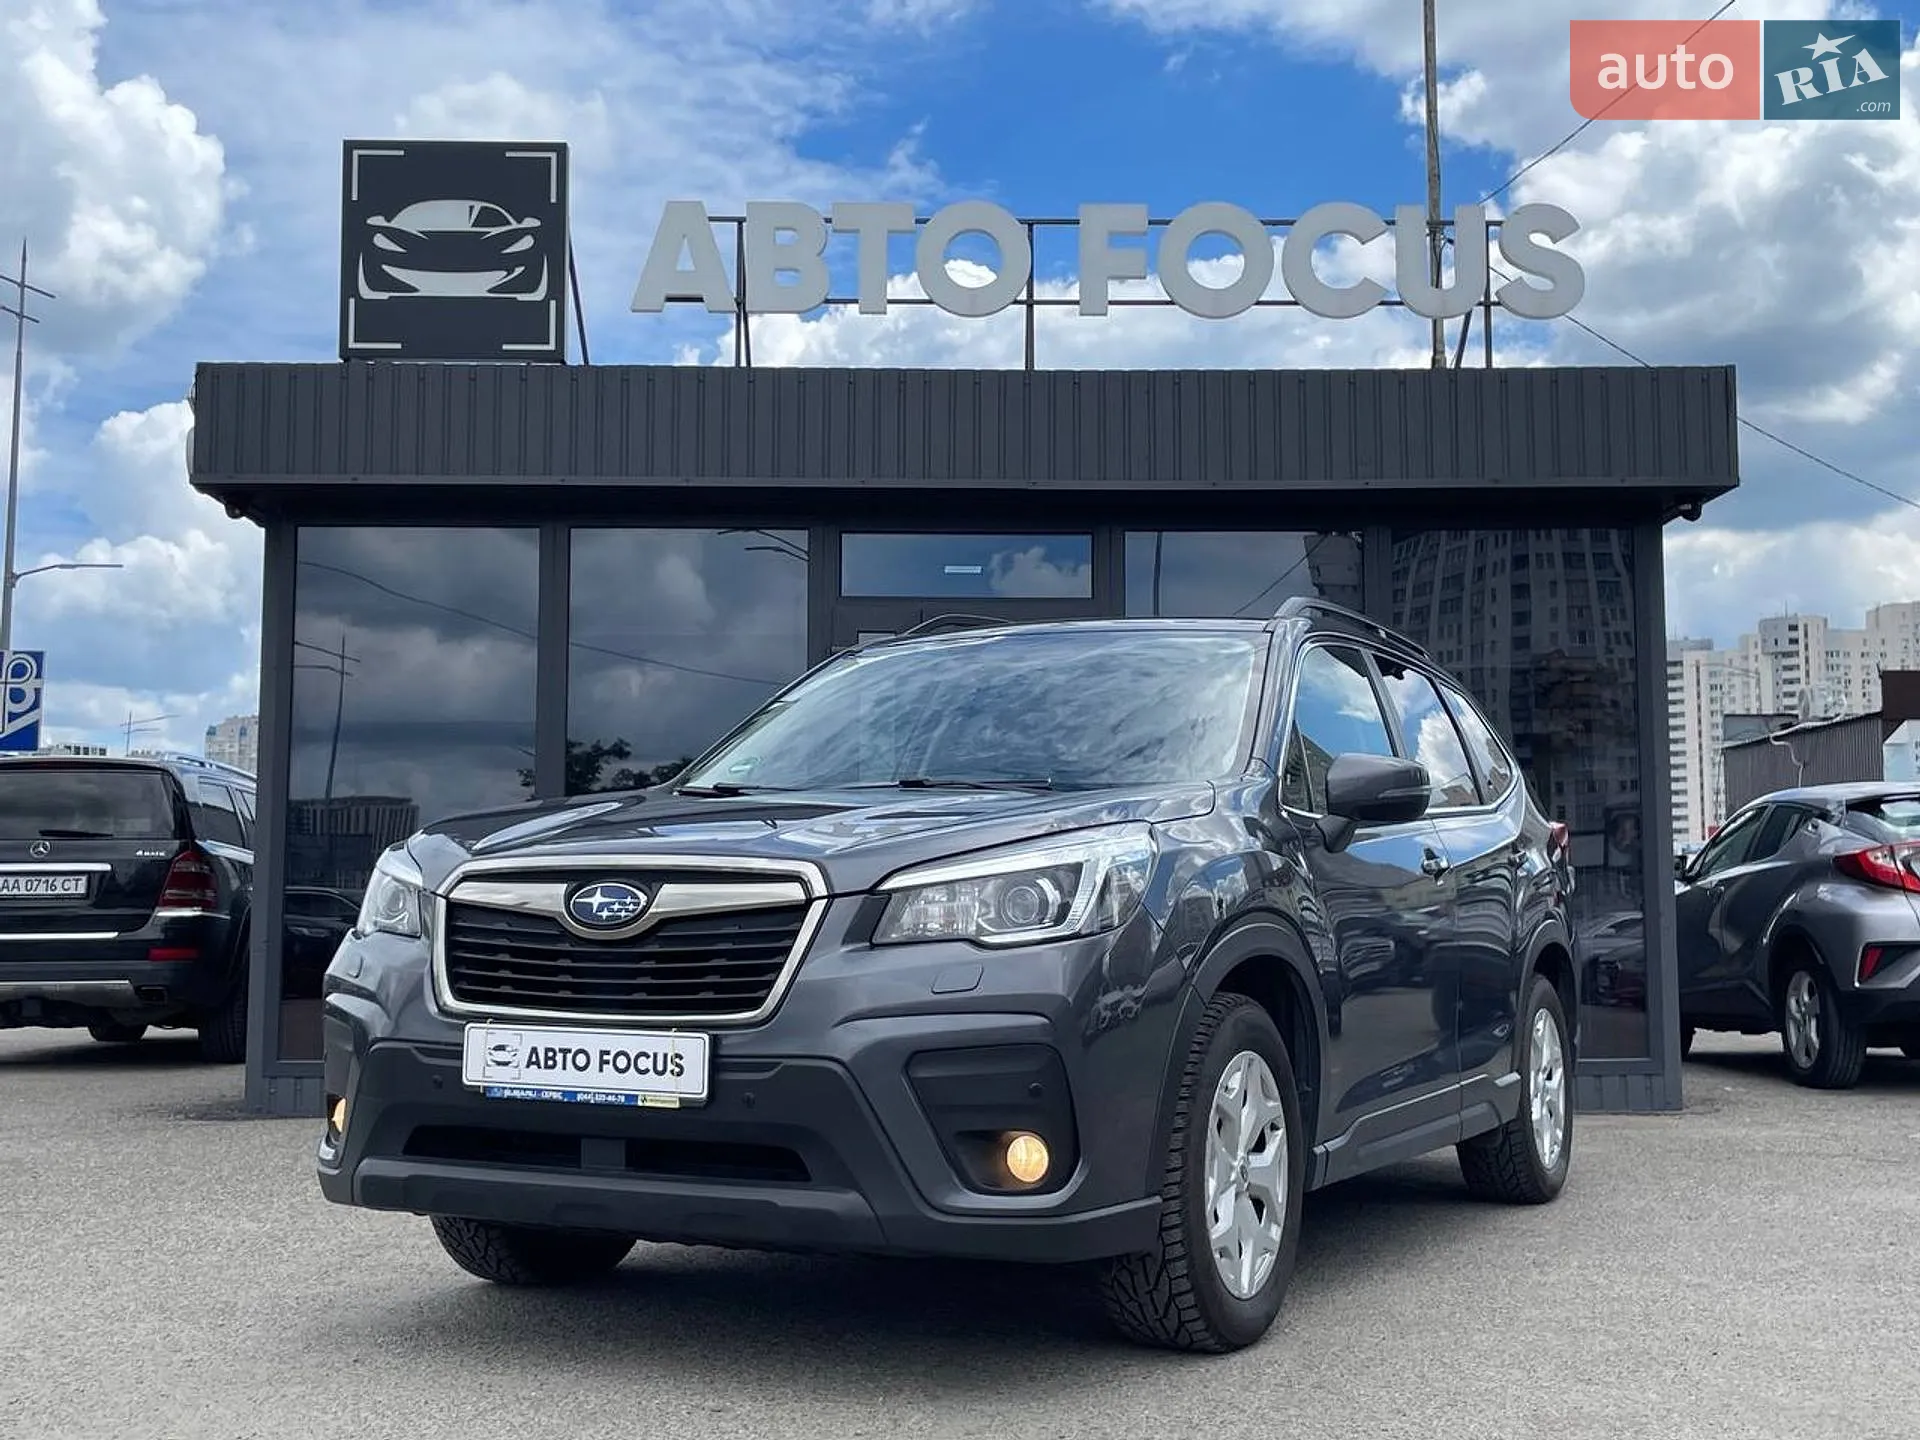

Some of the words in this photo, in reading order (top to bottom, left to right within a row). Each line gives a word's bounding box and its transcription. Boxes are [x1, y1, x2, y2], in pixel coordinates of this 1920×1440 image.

[1079, 202, 1585, 319] FOCUS
[1, 880, 21, 893] AA
[25, 879, 57, 892] 0716
[61, 878, 83, 892] CT
[598, 1049, 685, 1078] FOCUS
